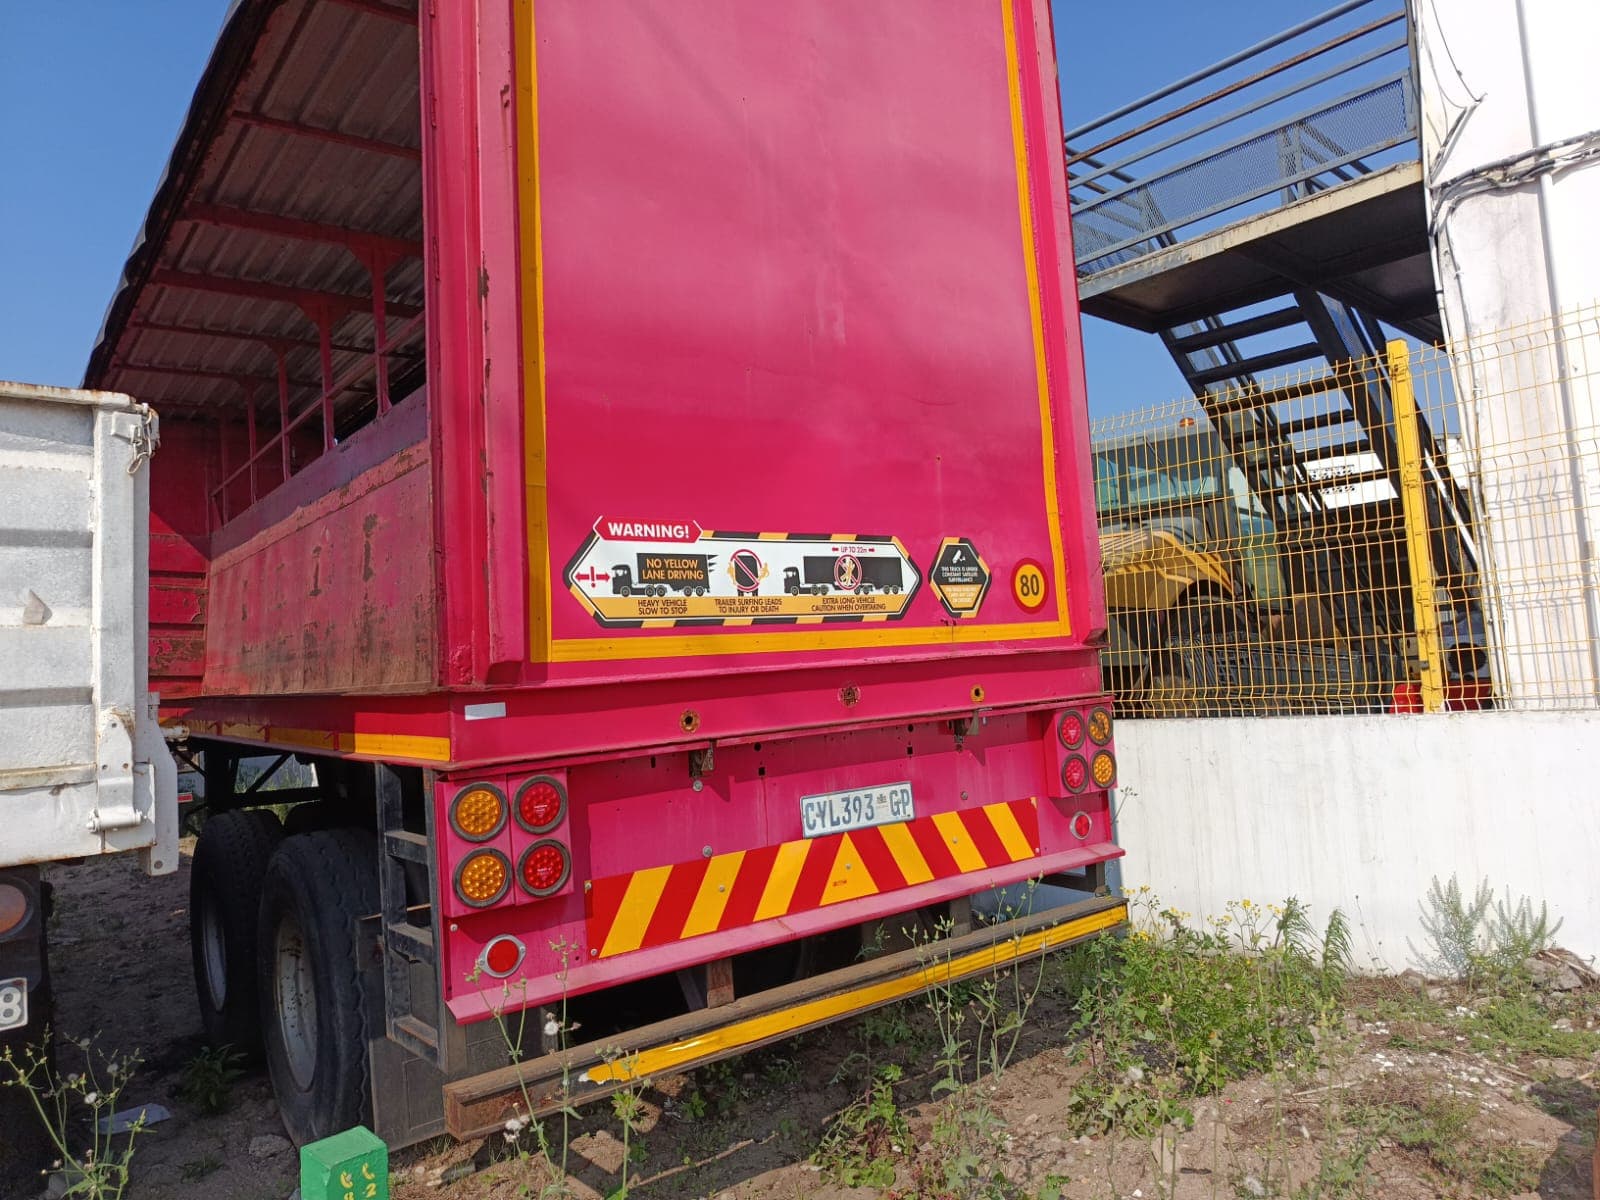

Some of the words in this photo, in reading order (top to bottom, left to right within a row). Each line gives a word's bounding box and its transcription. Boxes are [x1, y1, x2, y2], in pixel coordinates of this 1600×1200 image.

[608, 522, 690, 539] WARNING!
[646, 558, 662, 569] NO
[664, 558, 698, 569] YELLOW
[642, 569, 666, 580] LANE
[667, 570, 704, 580] DRIVING
[1020, 574, 1040, 597] 80
[637, 599, 660, 607] HEAVY
[661, 599, 688, 607] VEHICLE
[715, 598, 737, 606] TRAILER
[737, 598, 764, 606] SURFING
[765, 598, 783, 606] LEADS
[822, 597, 839, 605] EXTRA
[856, 596, 876, 604] VEHICLE
[639, 607, 659, 615] SLOW
[660, 607, 670, 615] TO
[671, 606, 688, 615] STOP
[719, 606, 728, 614] TO
[728, 605, 749, 613] INJURY
[750, 605, 760, 613] OR
[760, 605, 780, 613] DEATH
[812, 604, 836, 612] CAUTION
[854, 603, 887, 611] OVERTAKING
[804, 793, 875, 831] CYL393
[889, 788, 910, 817] GP
